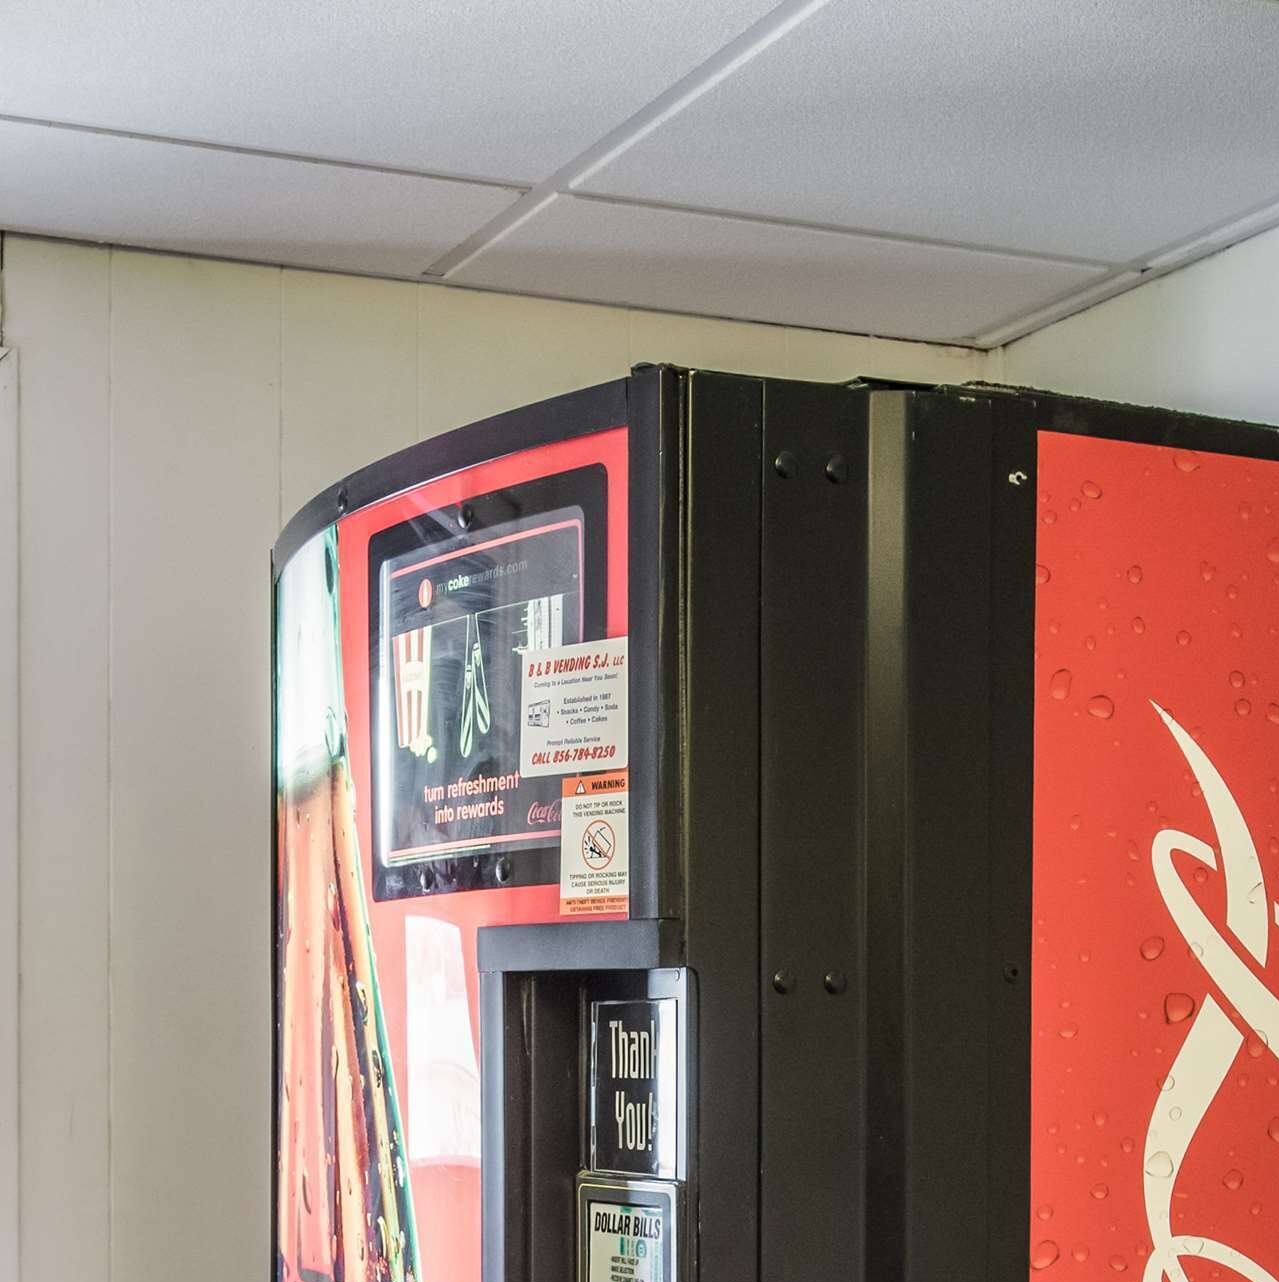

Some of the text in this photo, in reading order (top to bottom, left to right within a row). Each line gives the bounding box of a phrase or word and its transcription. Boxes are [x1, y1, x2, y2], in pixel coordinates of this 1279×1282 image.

[436, 560, 528, 594] mycokerewards.com
[528, 663, 535, 678] B
[544, 661, 551, 676] B
[553, 655, 591, 674] VENDING
[593, 653, 610, 669] S.J.
[613, 655, 625, 667] LLC
[560, 707, 579, 716] Snacks
[583, 705, 600, 713] Candy
[563, 695, 592, 705] Established
[570, 717, 587, 726] Coffee
[532, 745, 616, 765] CALL 856-784-8250
[424, 770, 520, 803] turn refreshment
[591, 778, 625, 791] WARNING
[435, 796, 504, 824] into rewards
[615, 1090, 654, 1152] You!
[594, 1211, 661, 1240] DOLLAR BILLS
